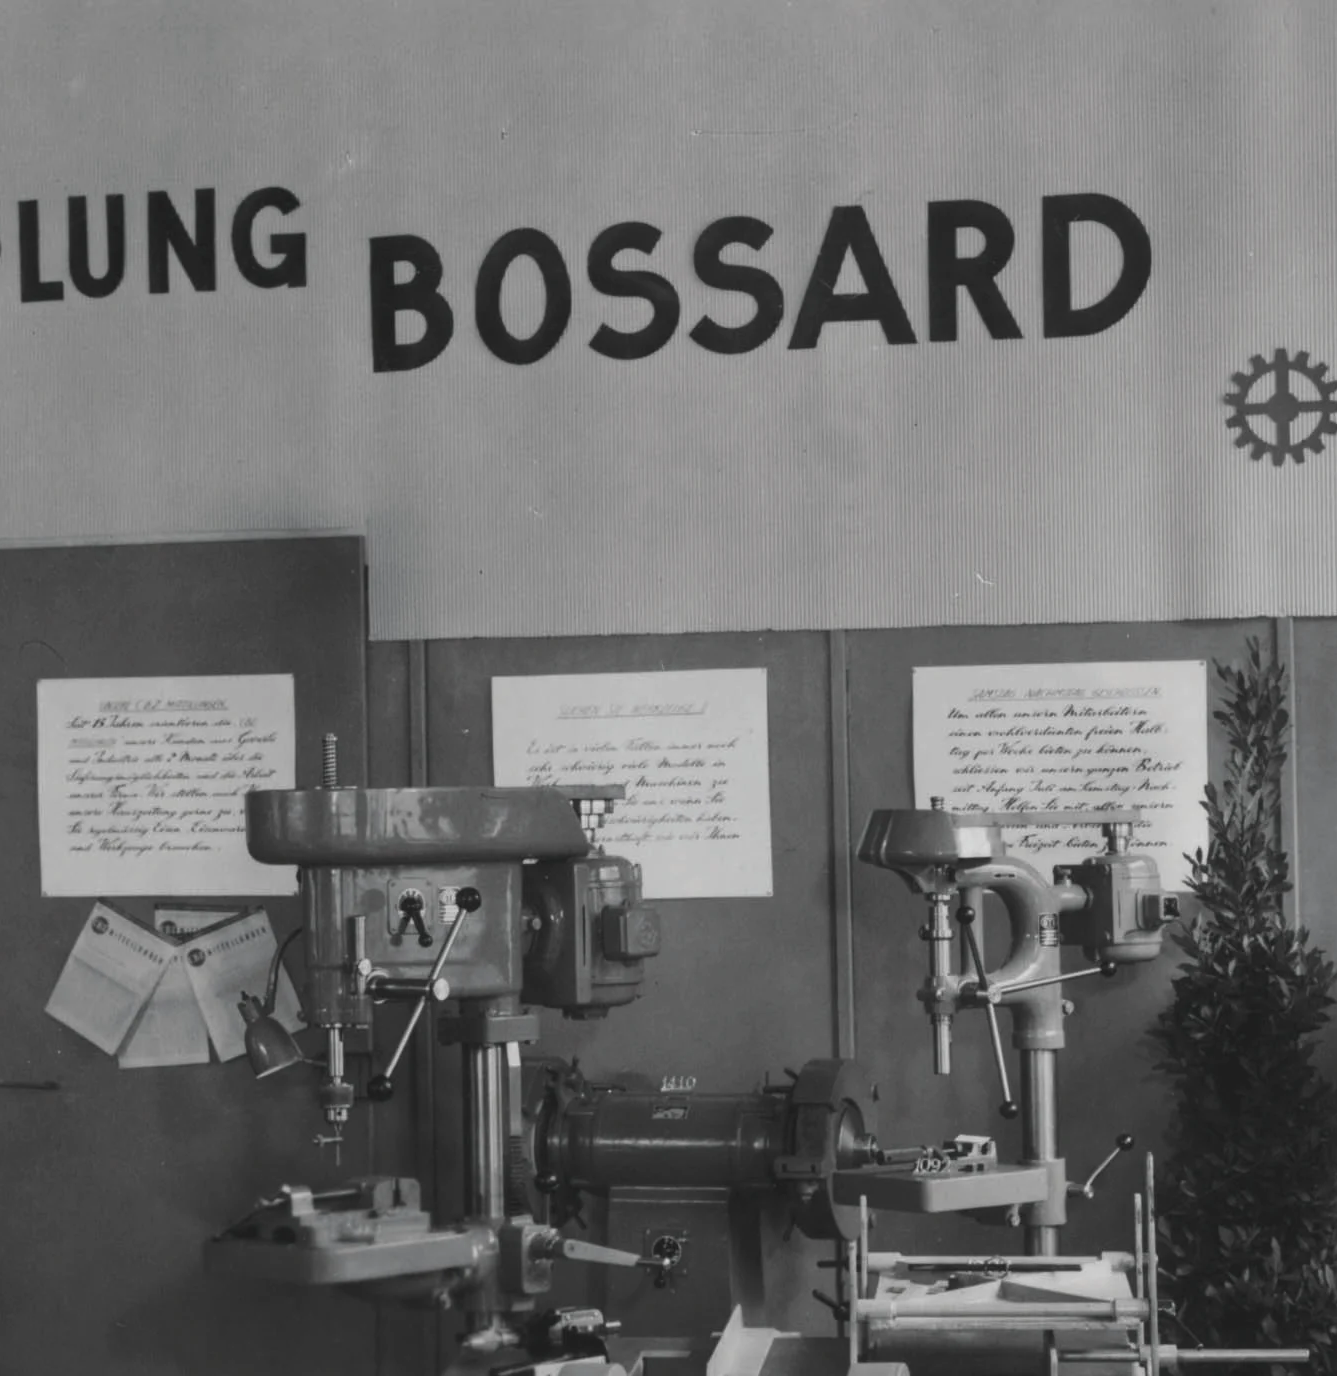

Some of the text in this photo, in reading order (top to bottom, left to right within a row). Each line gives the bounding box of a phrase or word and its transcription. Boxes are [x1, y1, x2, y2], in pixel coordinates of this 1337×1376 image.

[368, 192, 1152, 374] BOSSARD
[947, 708, 969, 719] Um
[974, 708, 1007, 718] allen
[1062, 704, 1148, 718] Mitarbeitern
[68, 716, 90, 727] Seit
[109, 714, 143, 728] Jahren
[162, 732, 205, 745] Kunden
[987, 725, 1083, 737] wohlverdienten
[1084, 726, 1124, 741] freien
[707, 736, 739, 749] noch
[949, 747, 971, 760] tag
[997, 740, 1033, 755] Woche
[1038, 746, 1072, 755] bieten
[1072, 748, 1092, 760] zu
[69, 754, 90, 762] und
[94, 750, 138, 763] Industrie
[180, 750, 218, 761] Monate
[222, 752, 243, 761] über
[196, 771, 219, 779] und
[243, 766, 276, 778] Arbeit
[561, 759, 614, 774] schwierig
[657, 756, 706, 769] Modelle
[952, 764, 1009, 775] schliessen
[1015, 766, 1035, 774] wir
[1086, 766, 1129, 777] ganzen
[1134, 757, 1183, 773] Betrieb
[635, 775, 702, 787] Maschinen
[953, 783, 975, 792] seit
[977, 780, 1024, 797] Anfang
[108, 801, 177, 820] Hauszeitung
[180, 809, 212, 819] gerne
[1001, 797, 1038, 813] Helfen
[1042, 797, 1061, 809] Sie
[67, 821, 83, 834] Sie
[69, 842, 92, 851] und
[99, 838, 153, 857] Werkzeuge
[1065, 836, 1098, 848] bieten
[661, 1076, 697, 1092] 1410
